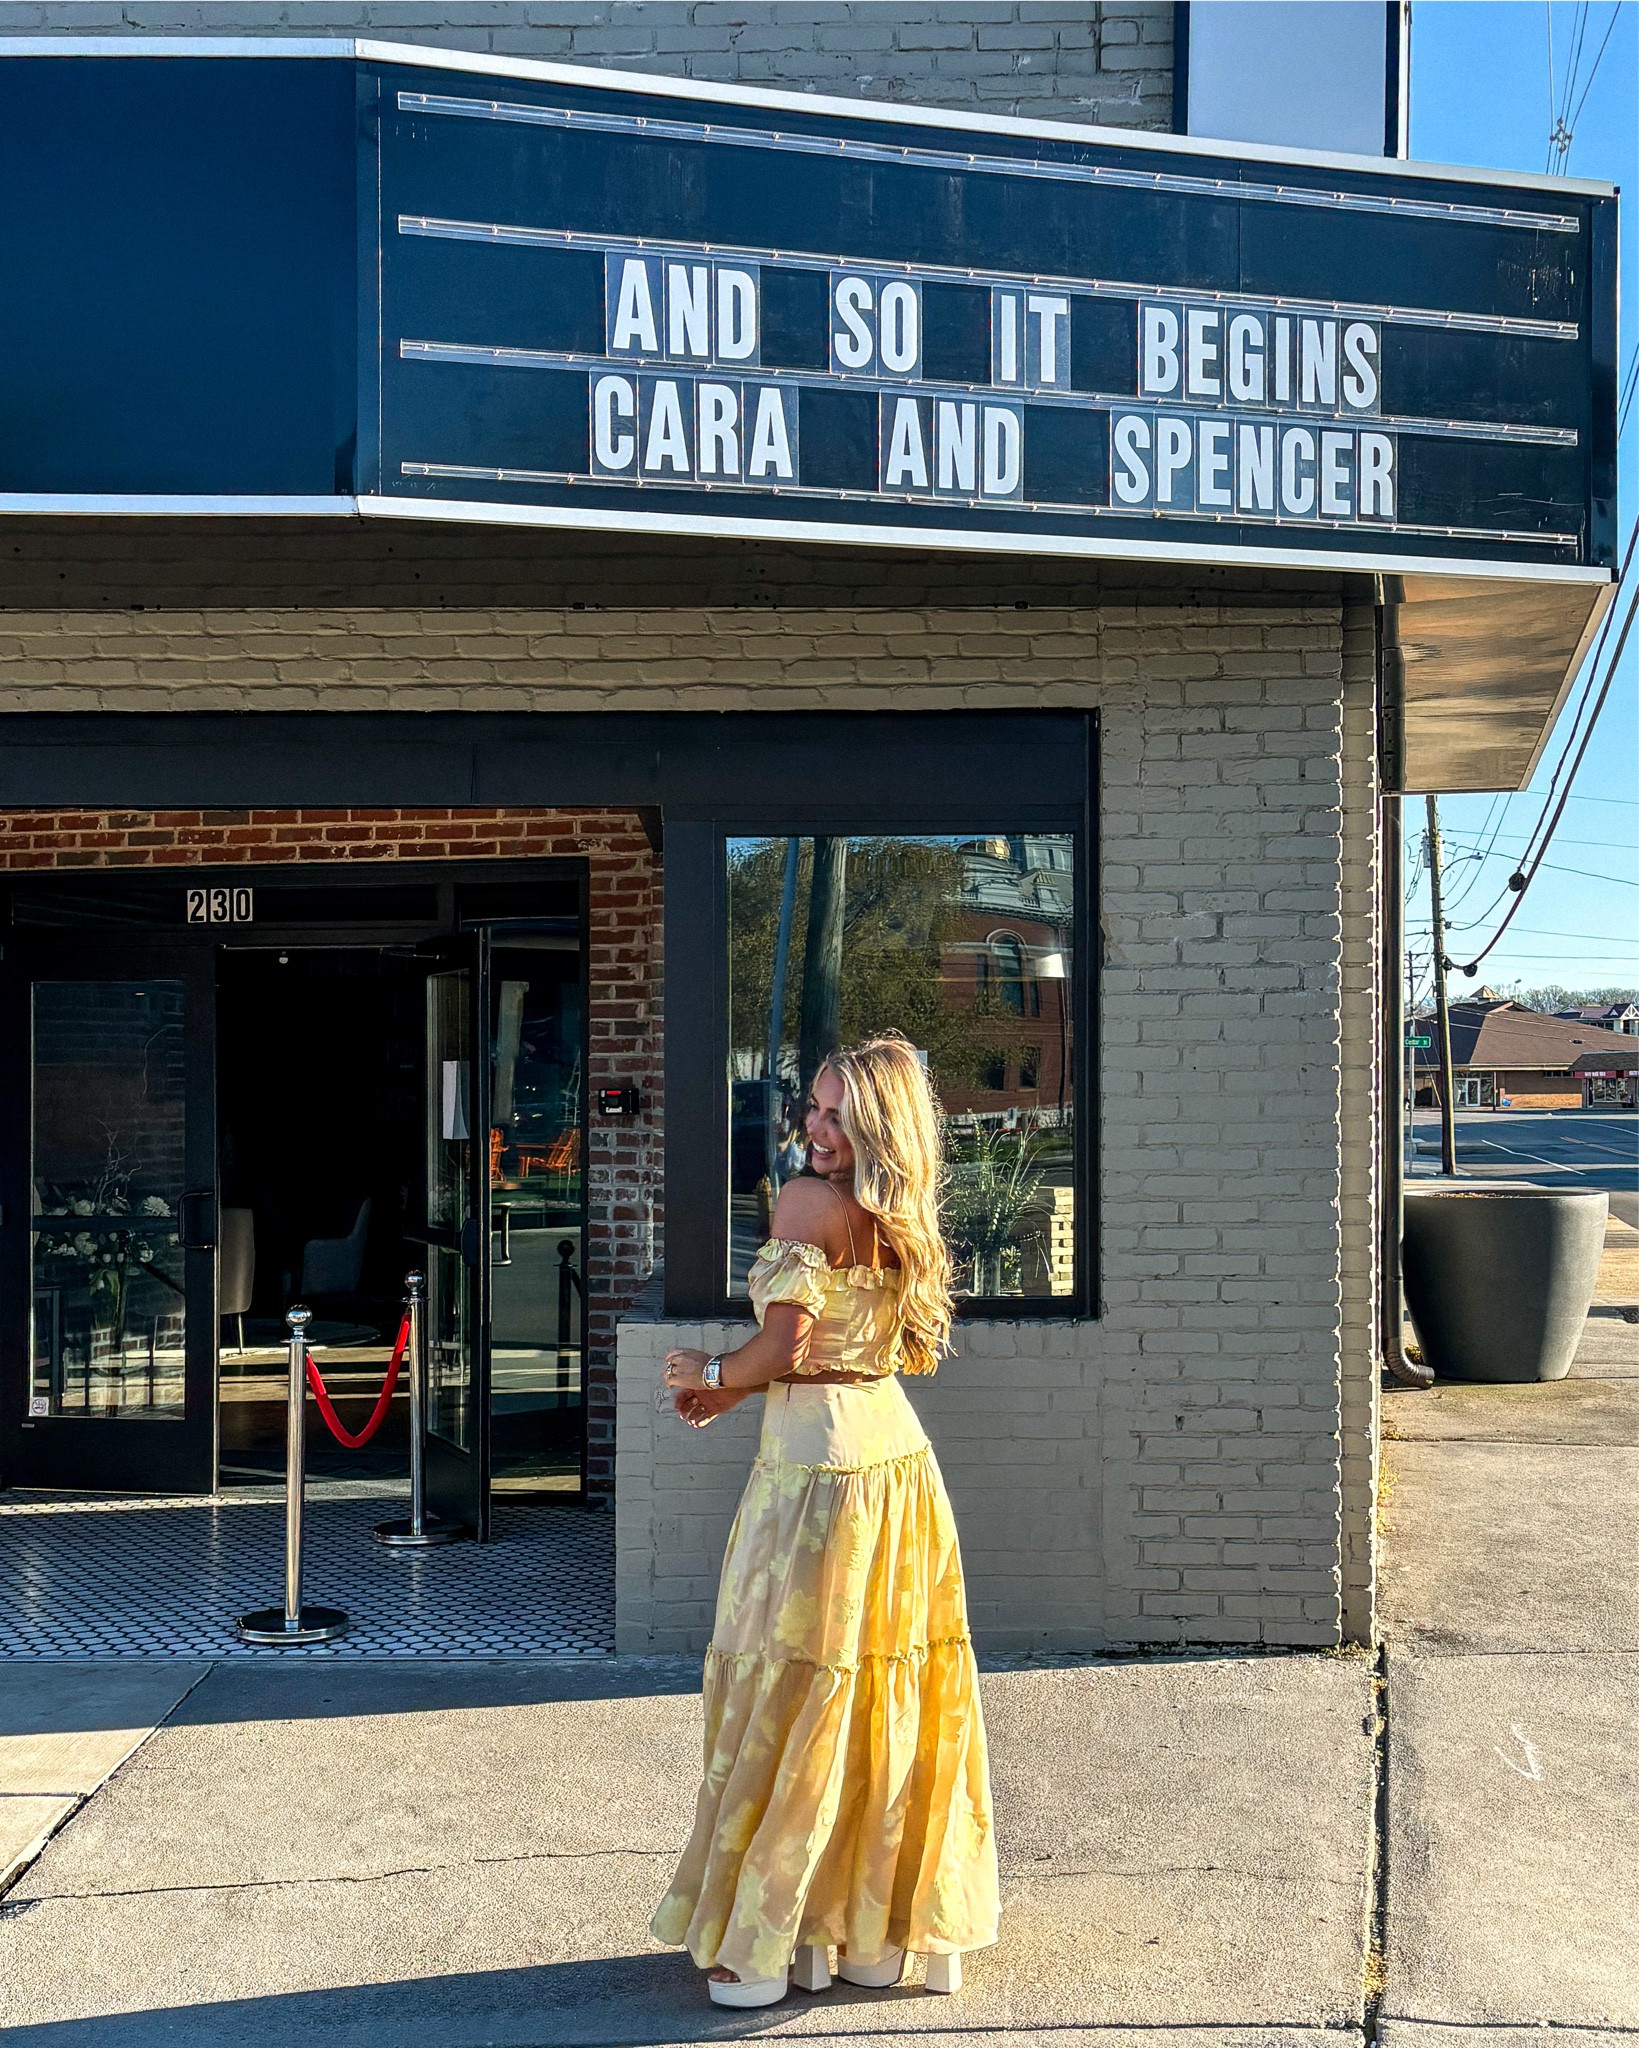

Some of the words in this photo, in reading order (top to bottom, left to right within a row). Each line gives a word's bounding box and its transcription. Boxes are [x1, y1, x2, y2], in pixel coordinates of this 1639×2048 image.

[612, 257, 757, 361] AND
[834, 276, 918, 373] SO
[1001, 294, 1068, 383] IT
[1144, 306, 1378, 409] BEGINS
[594, 375, 794, 478] CARA
[885, 397, 1020, 495] AND
[1114, 415, 1394, 517] SPENCER
[189, 889, 251, 922] 230
